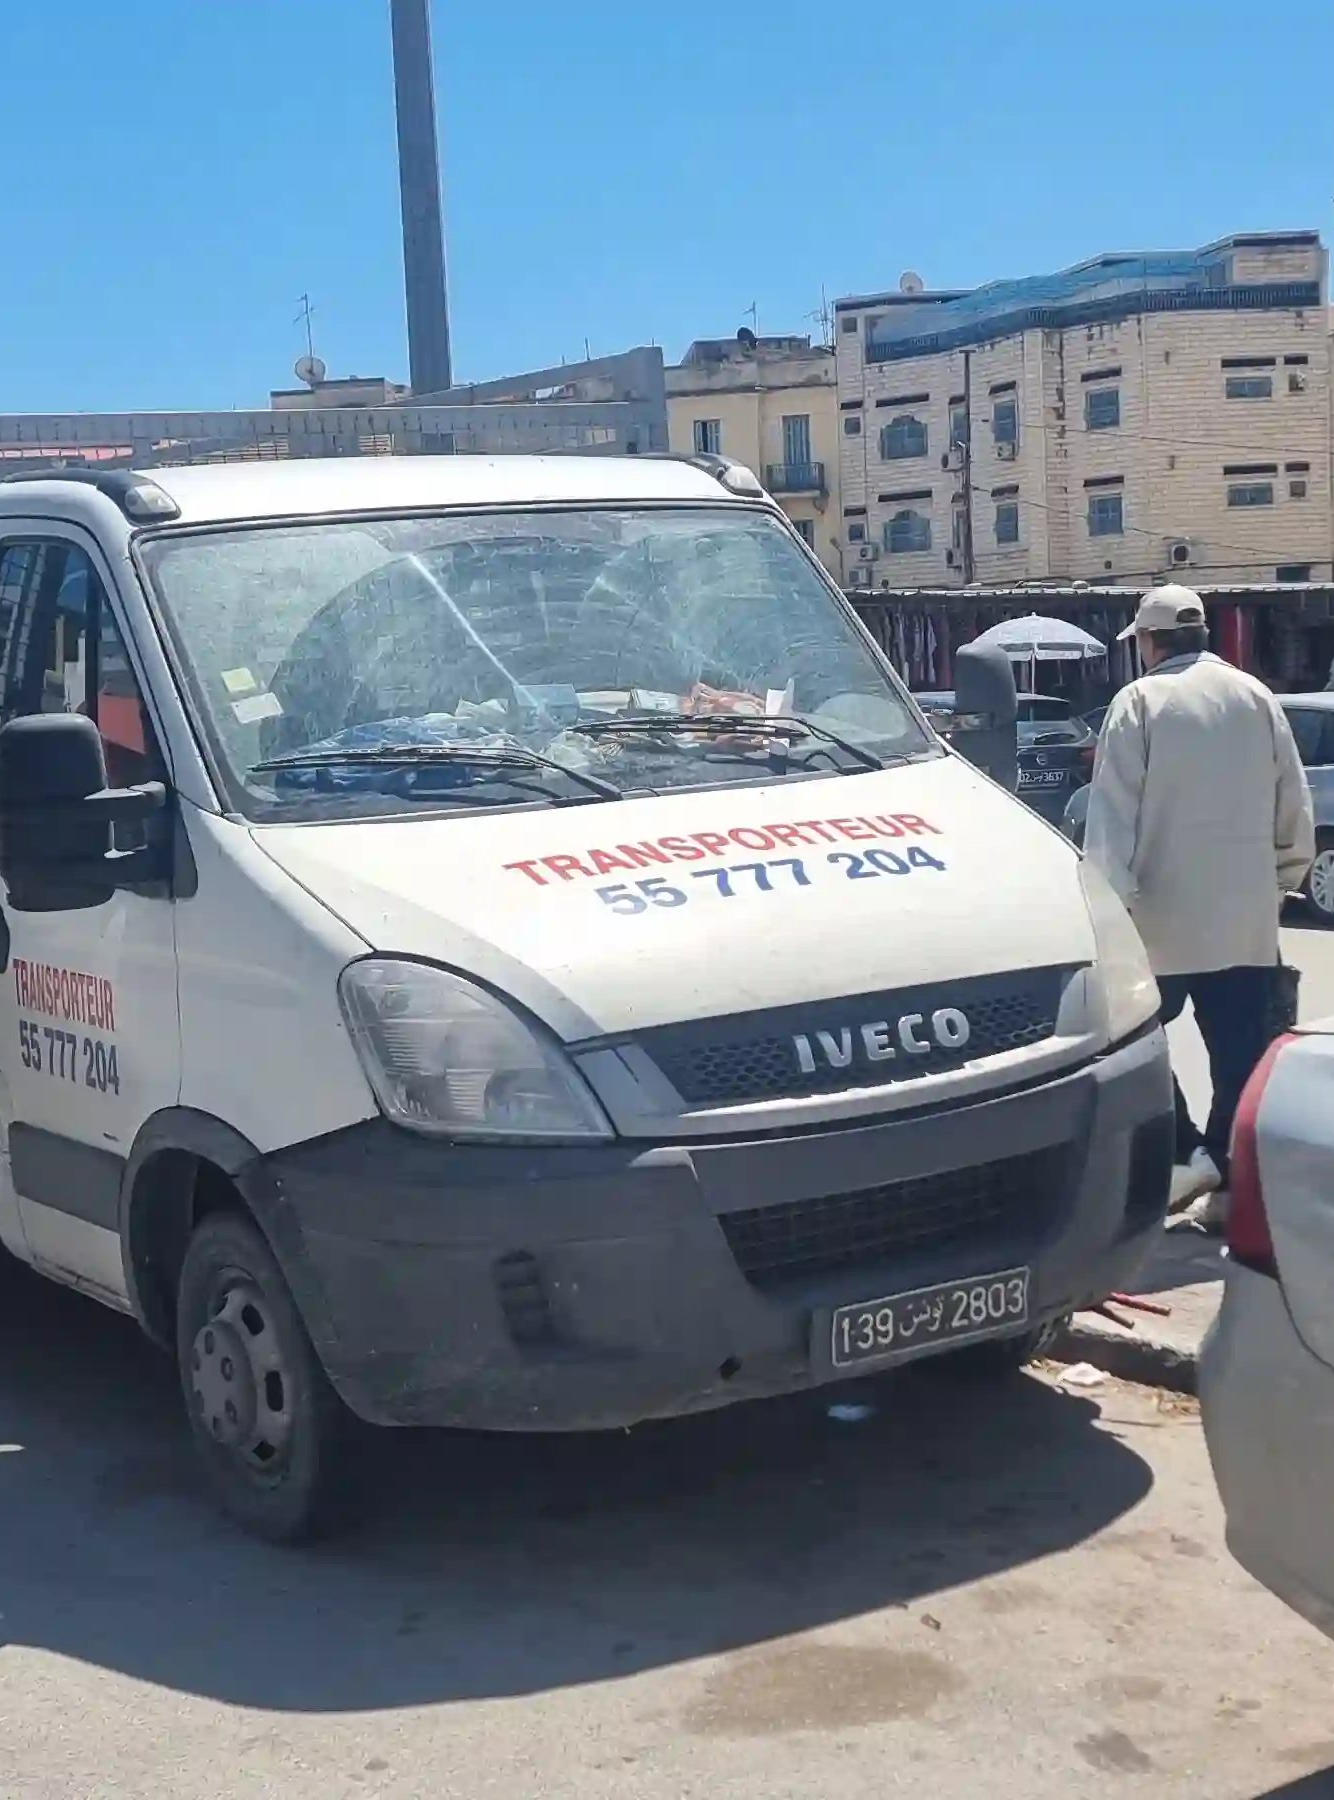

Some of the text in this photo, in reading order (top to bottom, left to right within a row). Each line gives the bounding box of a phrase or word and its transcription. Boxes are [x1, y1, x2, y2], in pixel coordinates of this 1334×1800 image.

[503, 813, 944, 887] TRANSPORTEUR
[593, 846, 948, 916] 55 777 204
[12, 957, 116, 1032] TRANSPORTEUR
[19, 1019, 120, 1097] 55 777 204
[792, 1007, 971, 1074] IVECO
[841, 1308, 894, 1354] 139
[951, 1278, 1024, 1329] 2803
